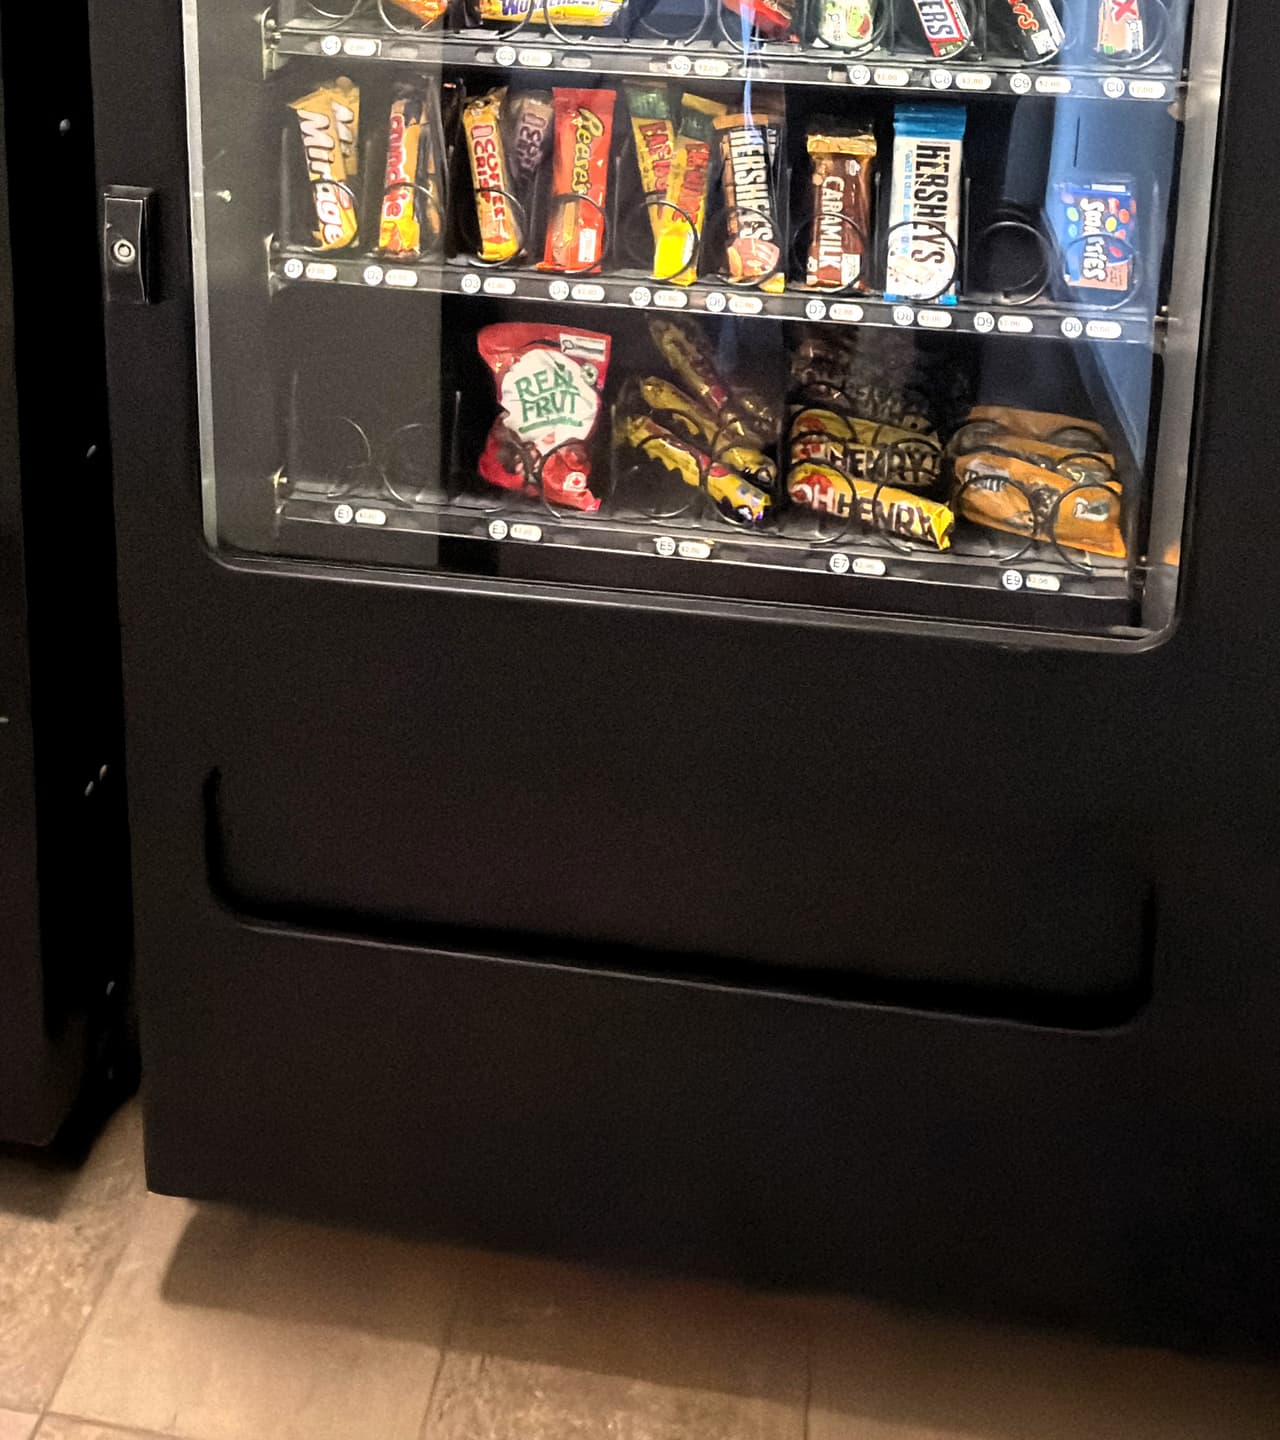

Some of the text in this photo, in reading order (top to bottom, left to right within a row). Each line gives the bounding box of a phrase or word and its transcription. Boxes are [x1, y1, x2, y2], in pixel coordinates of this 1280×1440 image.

[852, 70, 868, 81] C7
[1013, 78, 1030, 89] C9
[572, 107, 605, 195] Reese's
[295, 108, 344, 245] Mirage
[911, 144, 951, 264] HERSHEY'S
[818, 175, 845, 269] CARAMILK
[809, 304, 824, 315] D7
[977, 317, 993, 328] D9
[791, 483, 836, 514] OH
[338, 508, 350, 519] E1
[660, 540, 673, 551] E5
[832, 558, 847, 569] E7
[1006, 575, 1021, 586] E9
